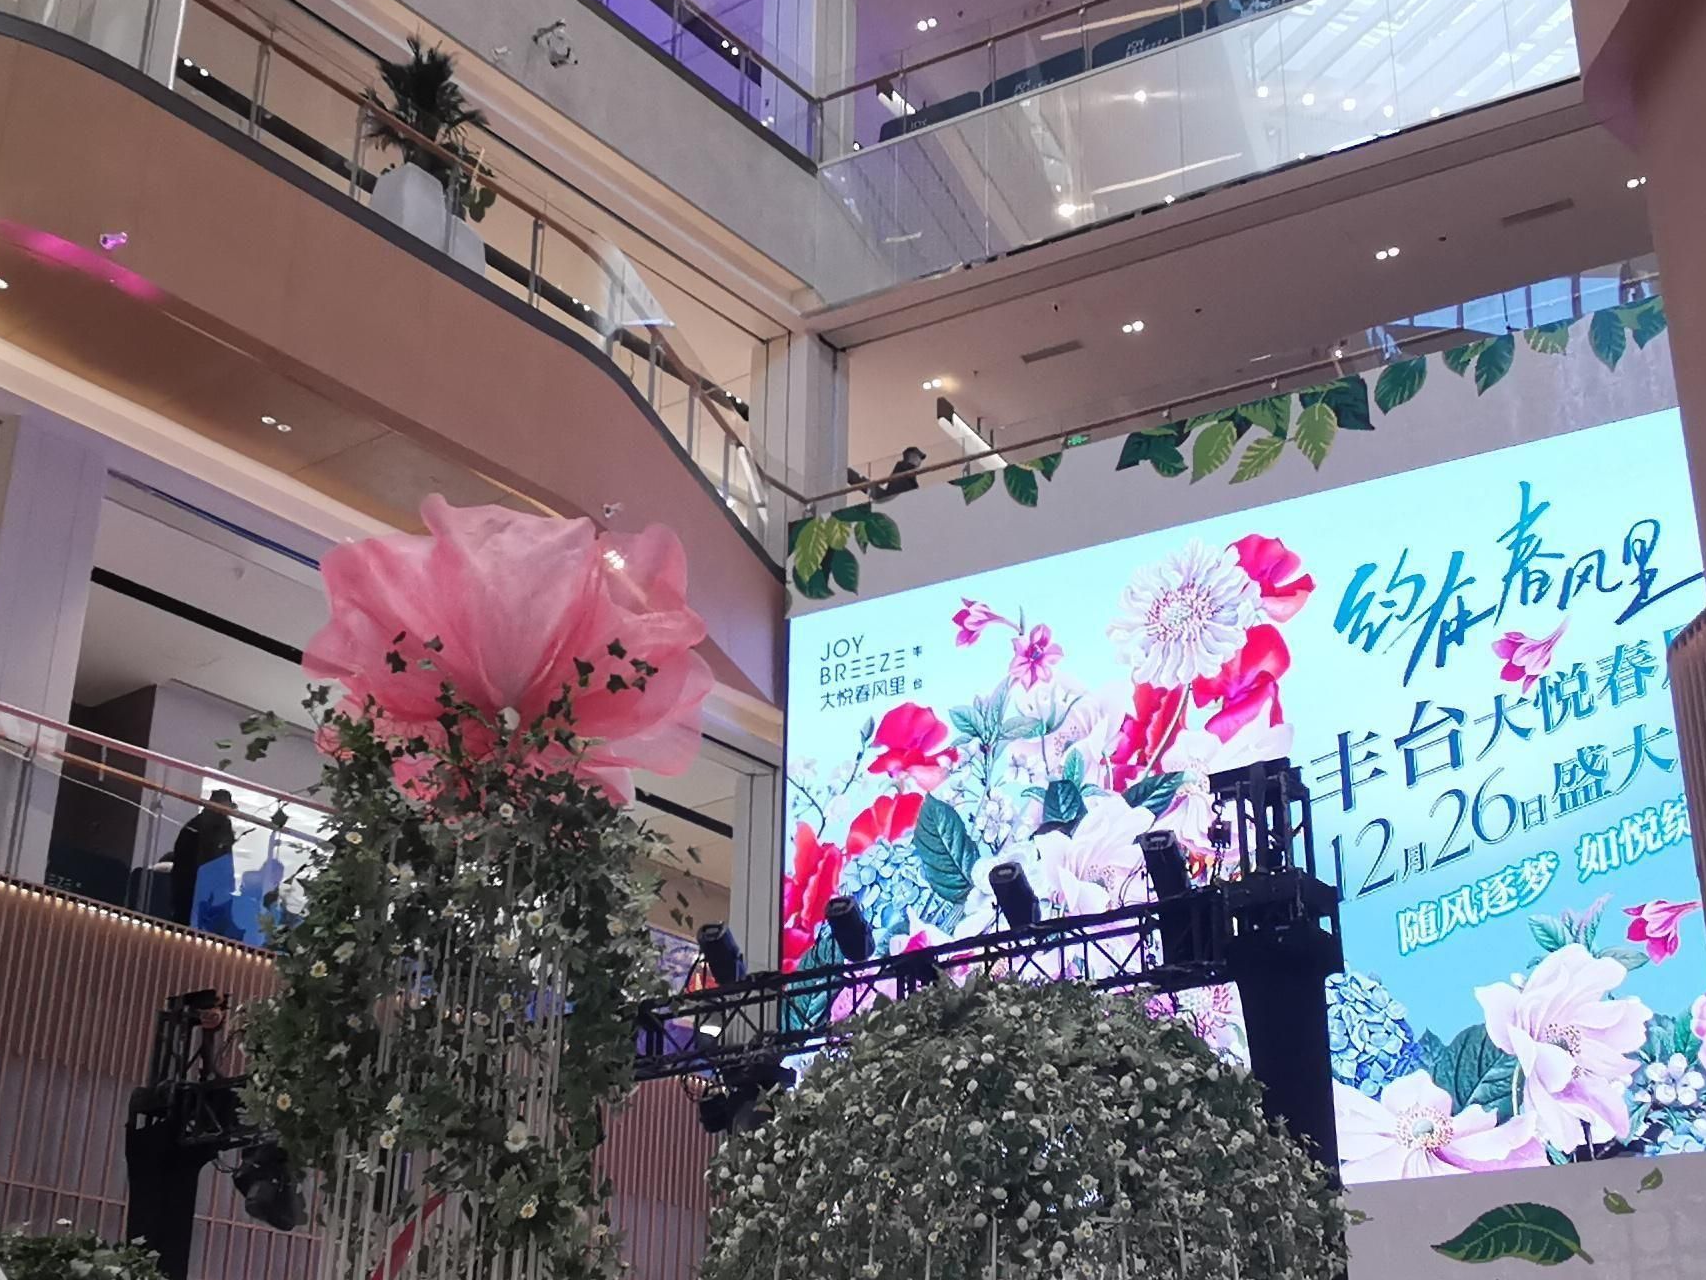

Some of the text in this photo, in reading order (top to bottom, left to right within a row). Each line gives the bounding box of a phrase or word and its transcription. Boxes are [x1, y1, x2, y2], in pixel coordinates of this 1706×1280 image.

[1333, 481, 1705, 688] 约在春风里
[820, 634, 864, 662] JOY
[820, 649, 905, 686] BREEZE
[820, 675, 905, 712] 大悦春风里
[1395, 851, 1559, 955] 随风逐梦
